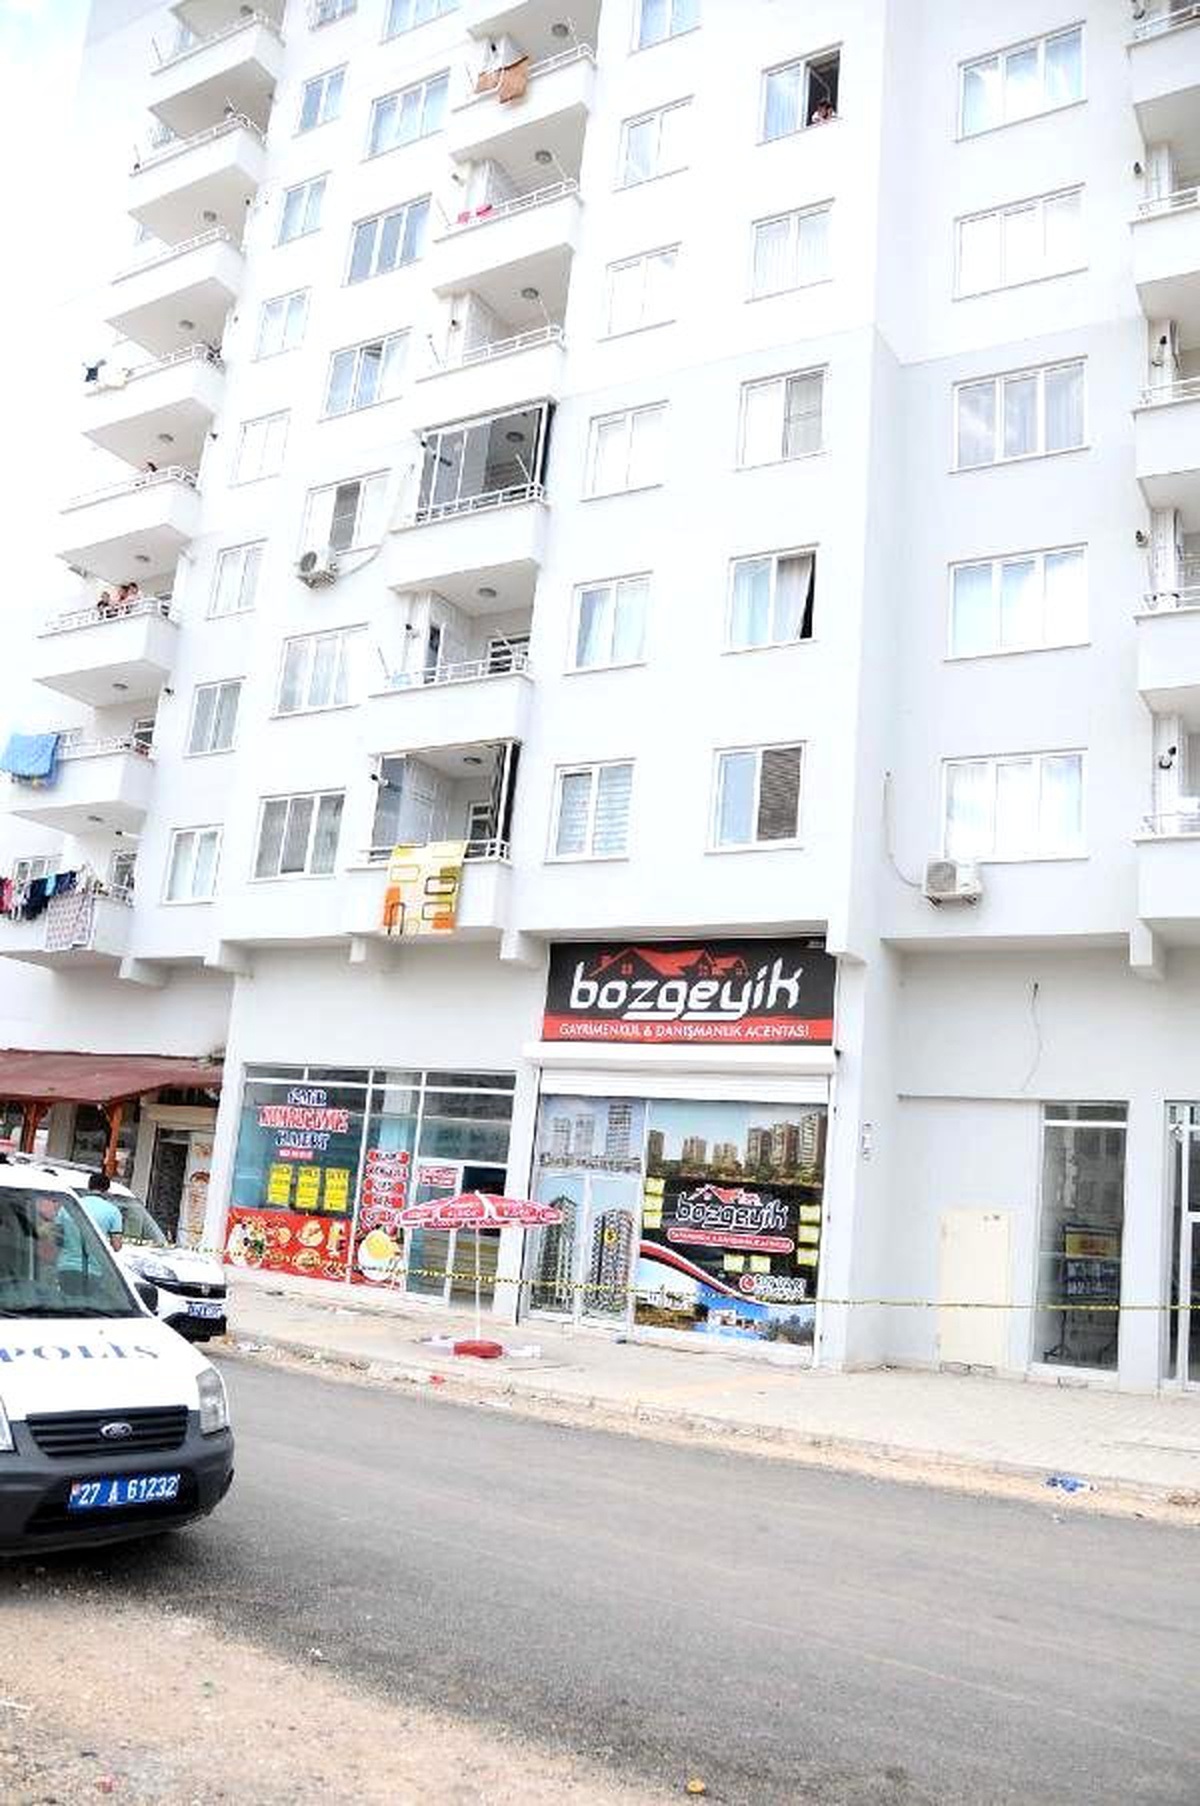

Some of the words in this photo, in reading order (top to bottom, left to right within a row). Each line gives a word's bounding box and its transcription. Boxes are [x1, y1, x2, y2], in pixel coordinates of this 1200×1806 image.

[569, 956, 803, 1021] bozgeyik
[643, 1024, 653, 1037] &
[745, 1024, 809, 1038] ACENTASI
[676, 1191, 789, 1235] bozgeyik
[78, 1483, 101, 1505] 27
[107, 1481, 118, 1503] A
[127, 1475, 179, 1500] 61232
